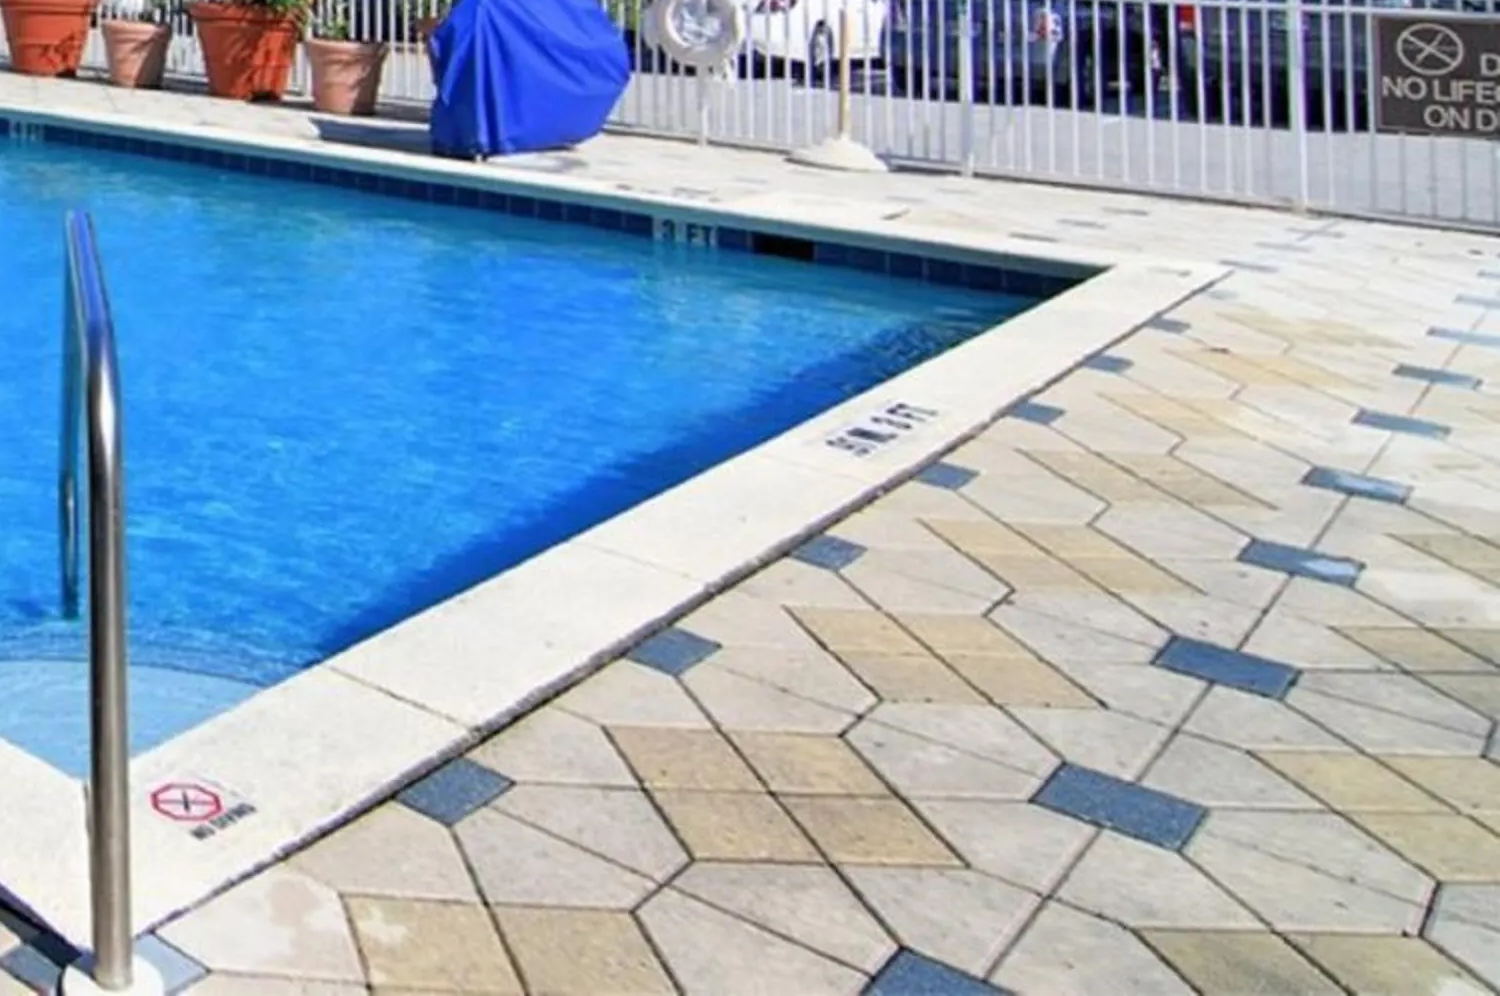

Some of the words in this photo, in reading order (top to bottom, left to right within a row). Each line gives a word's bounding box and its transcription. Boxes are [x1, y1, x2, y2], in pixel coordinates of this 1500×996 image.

[1381, 75, 1427, 101] NO
[1432, 79, 1500, 105] LIFE
[1423, 105, 1470, 130] ON
[686, 223, 713, 245] FT
